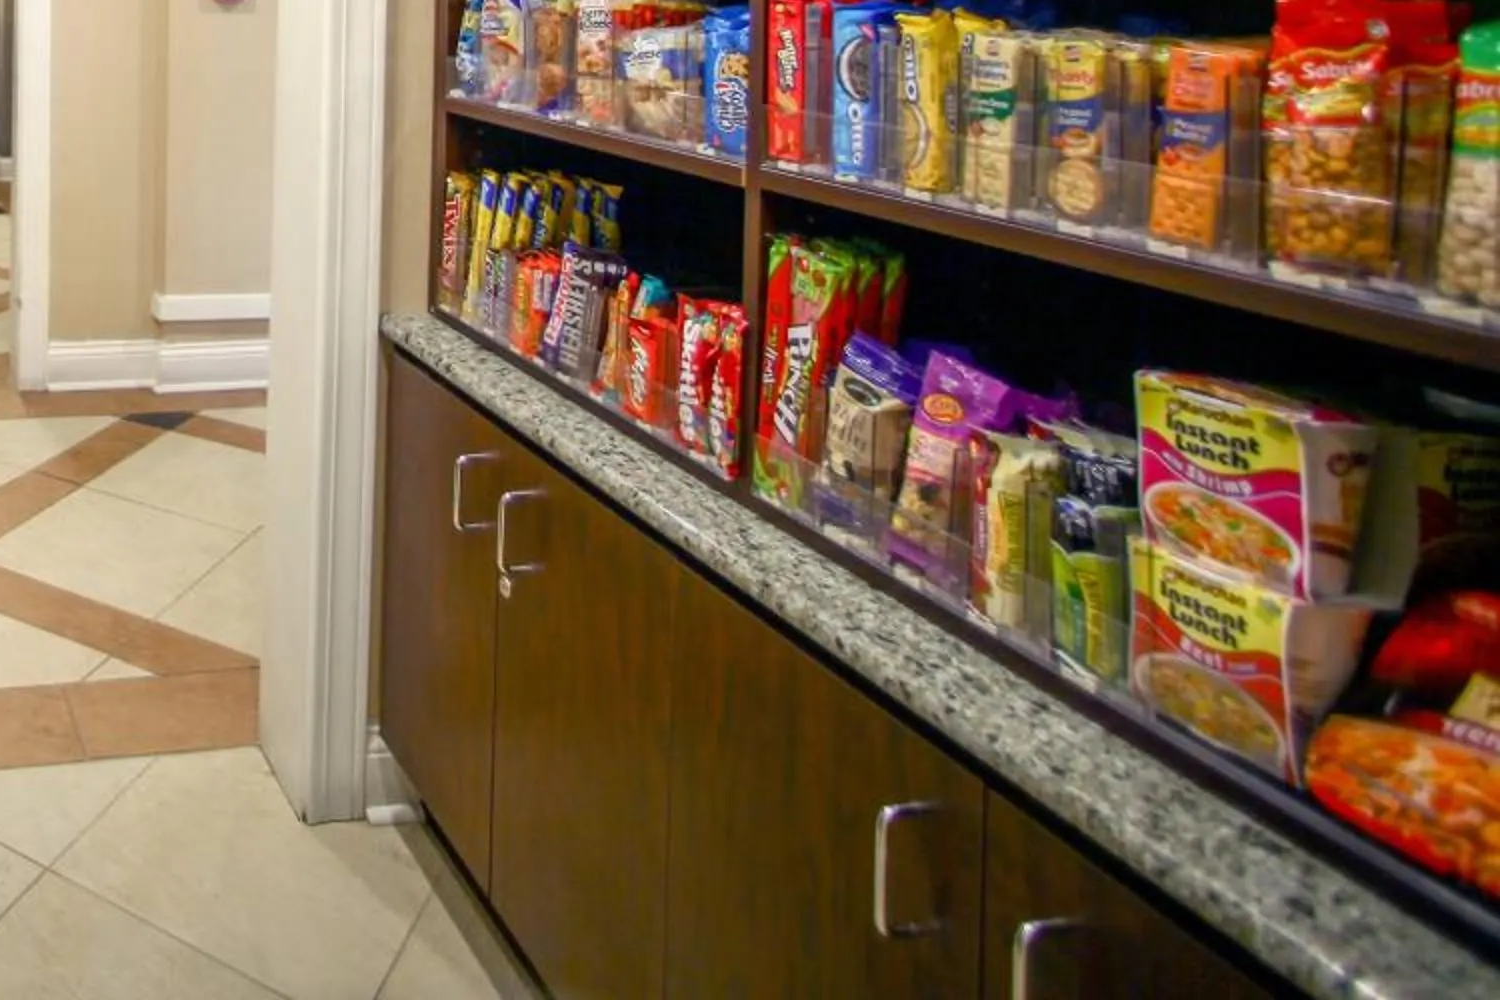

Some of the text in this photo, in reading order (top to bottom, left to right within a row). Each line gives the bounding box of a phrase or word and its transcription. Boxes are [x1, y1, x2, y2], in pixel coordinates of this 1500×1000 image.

[902, 35, 918, 103] OREO
[848, 103, 865, 166] OREO
[678, 319, 702, 443] Skittles
[1166, 410, 1261, 455] Instant
[1175, 434, 1251, 470] Lunch
[1160, 580, 1248, 635] Instant
[1170, 602, 1239, 650] Lunch
